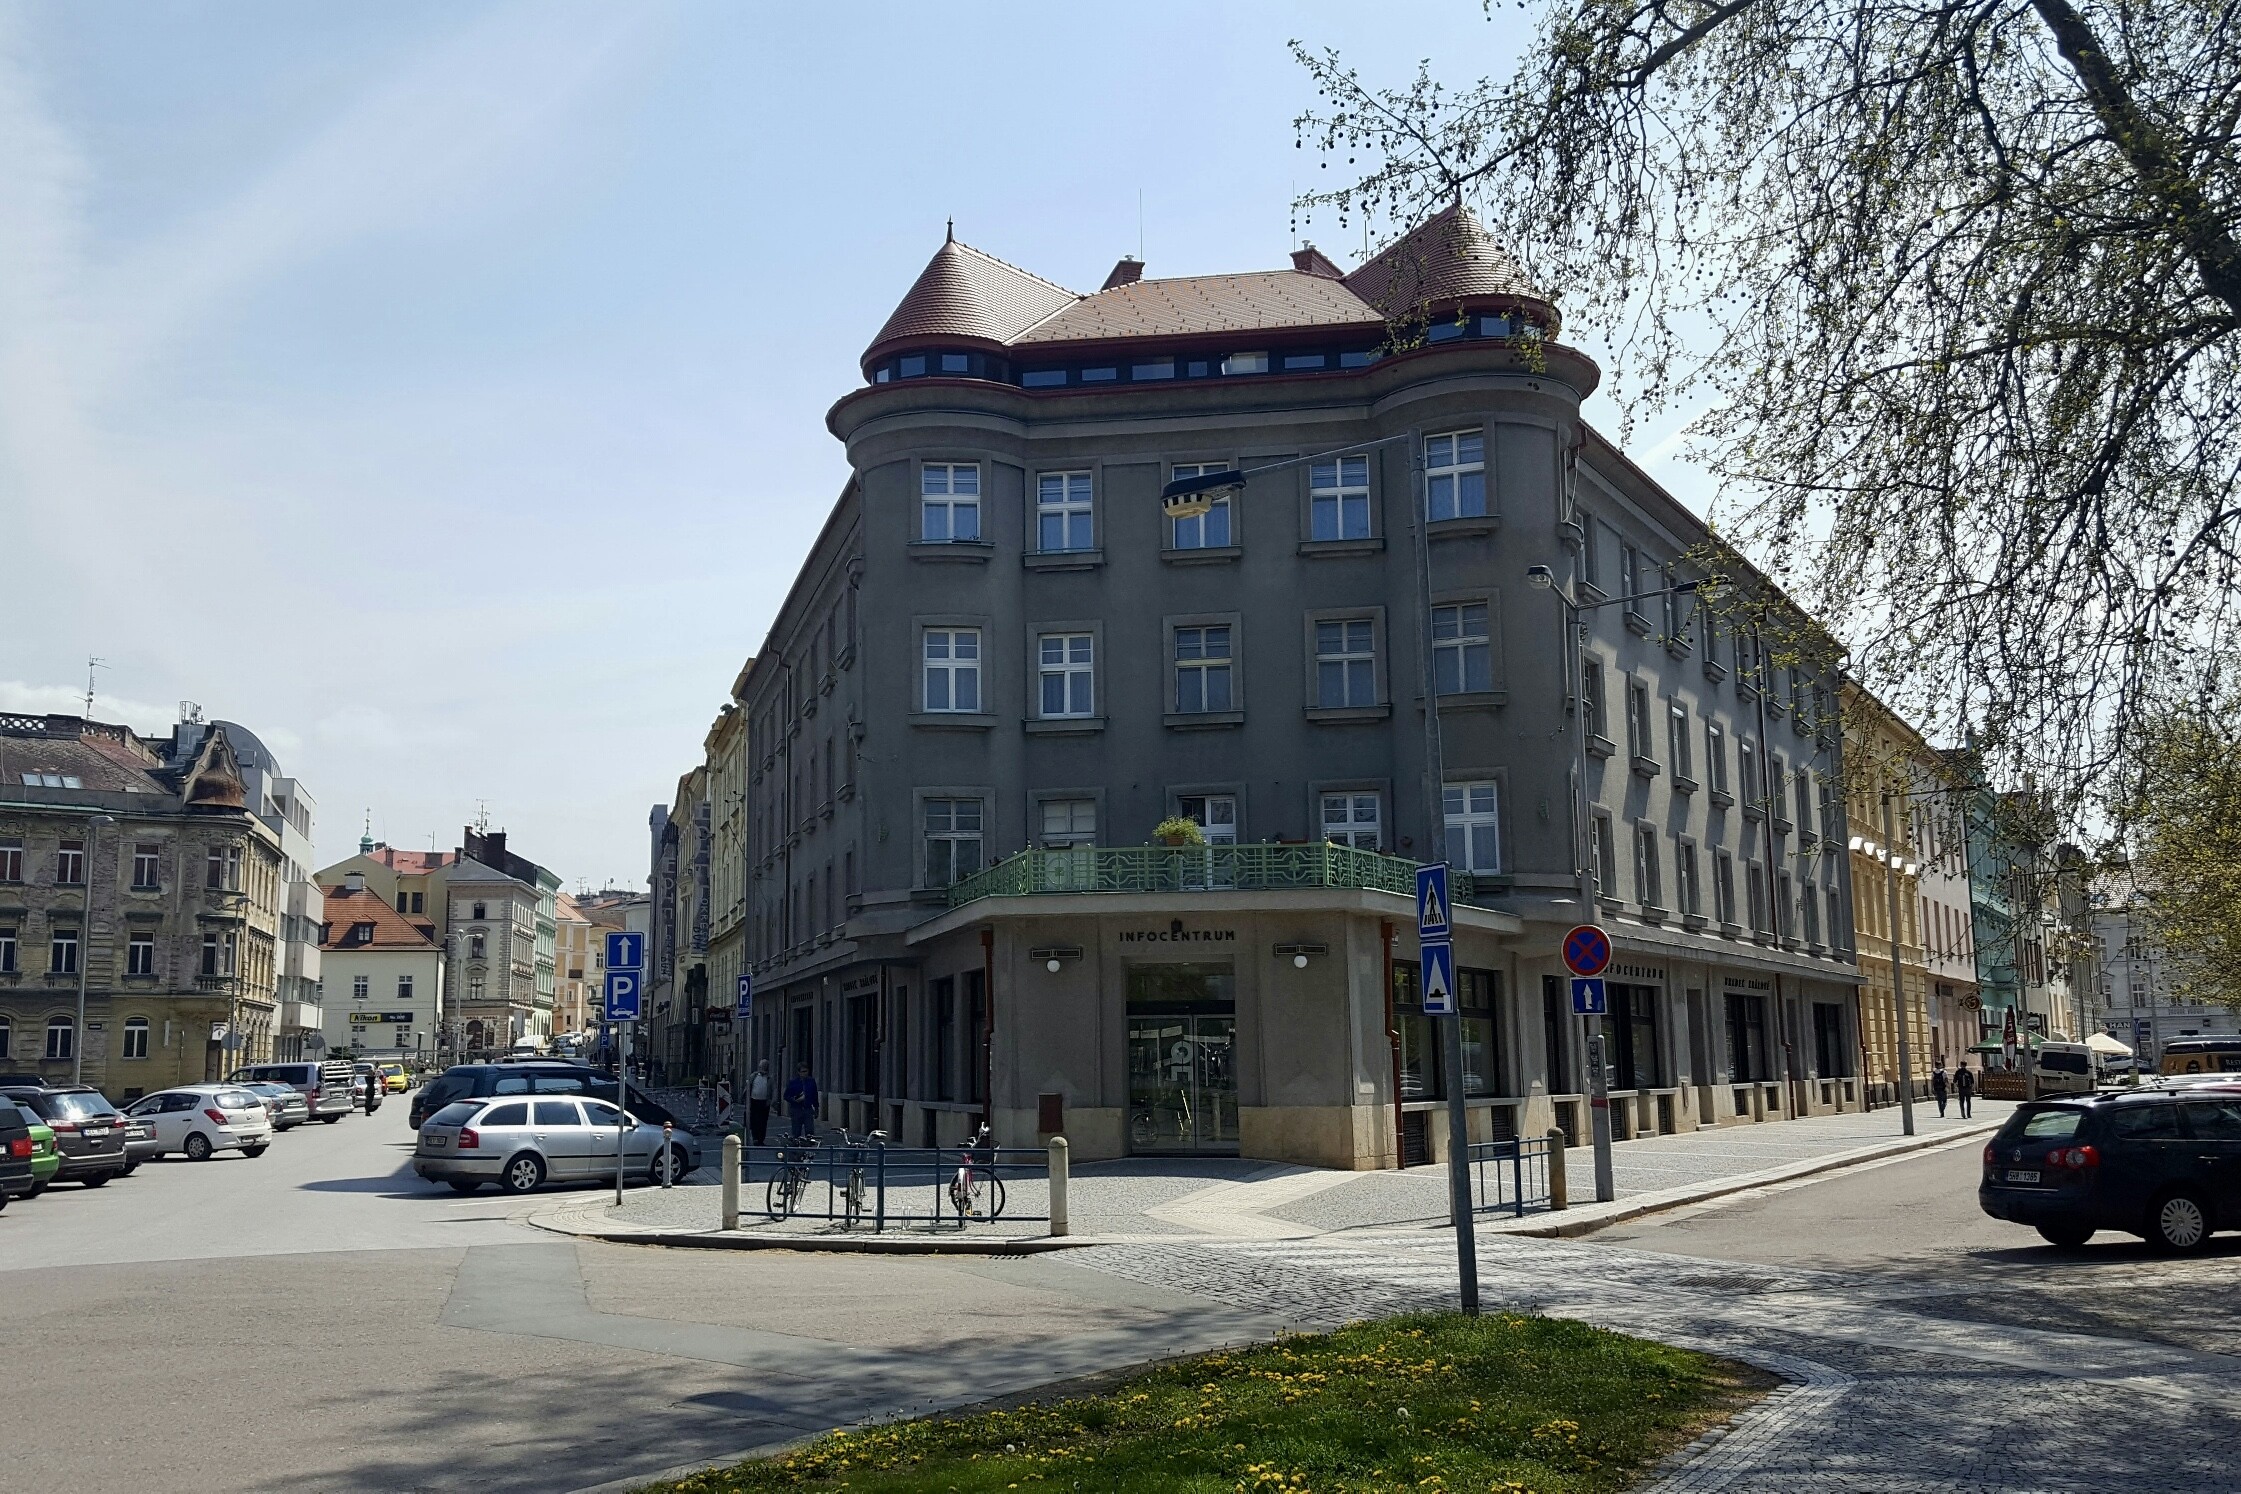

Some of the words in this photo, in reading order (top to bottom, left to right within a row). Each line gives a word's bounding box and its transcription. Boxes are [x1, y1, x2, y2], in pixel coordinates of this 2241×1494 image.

[694, 801, 711, 898] HOTEL
[1119, 930, 1235, 941] INFOCENTRUM
[612, 976, 633, 1005] P
[740, 980, 749, 1005] P
